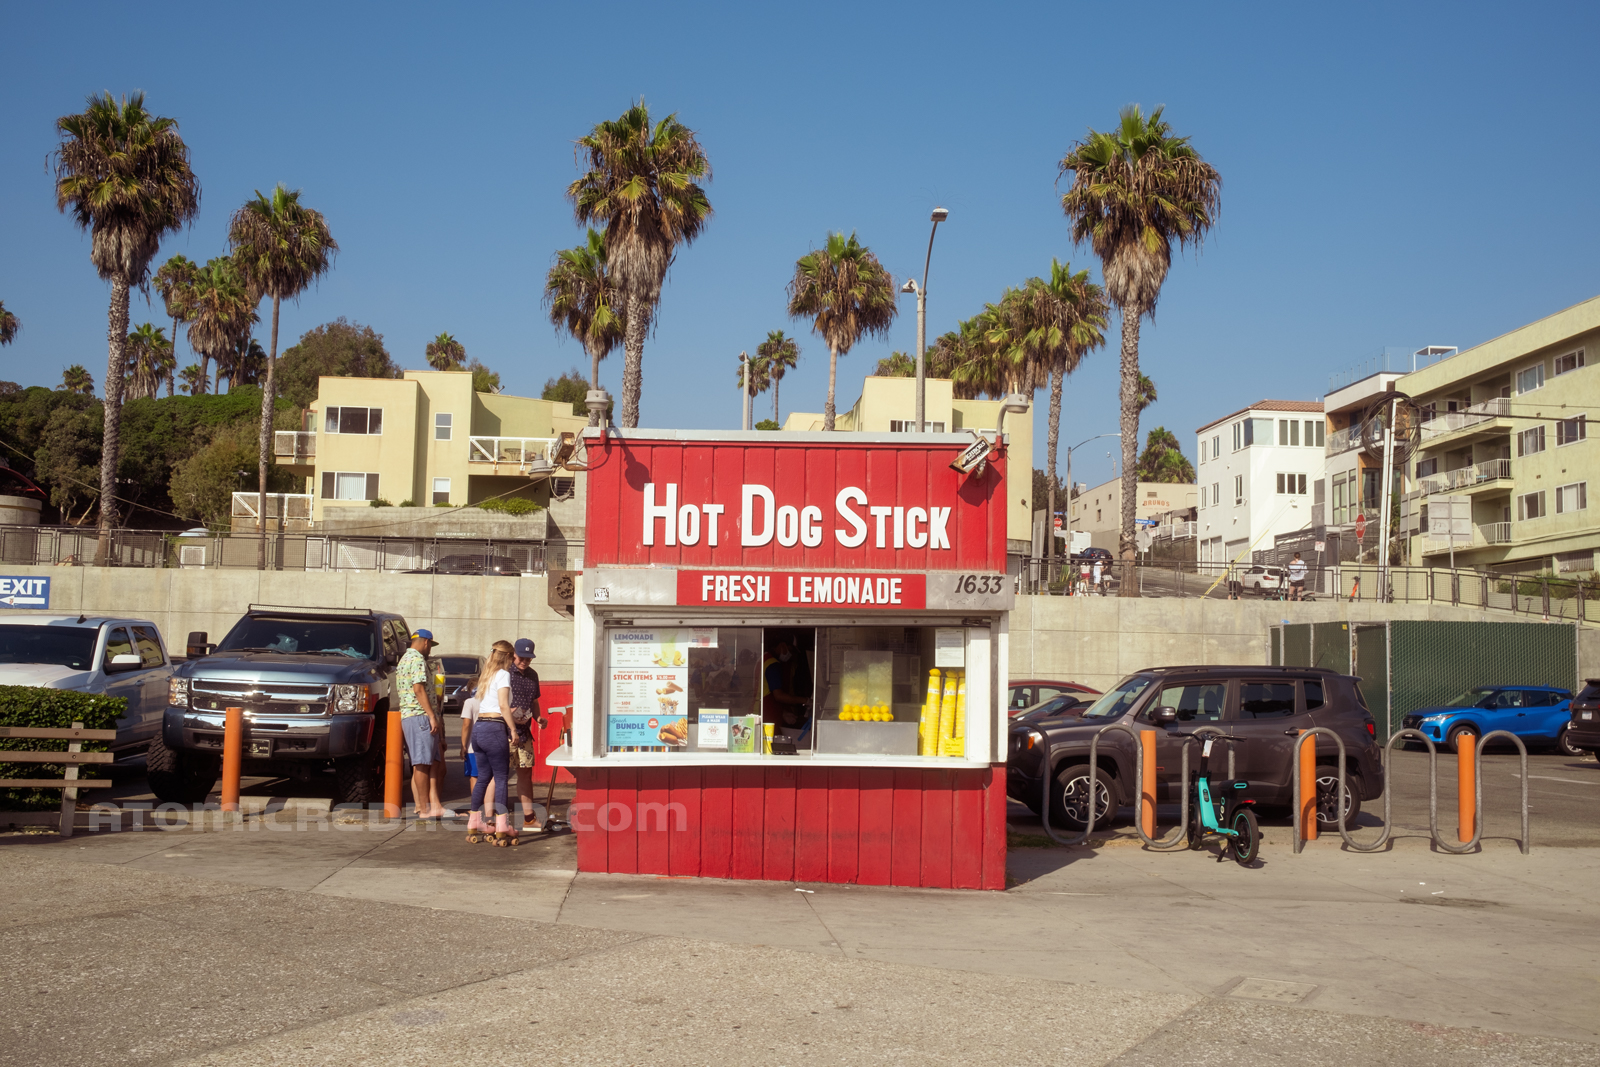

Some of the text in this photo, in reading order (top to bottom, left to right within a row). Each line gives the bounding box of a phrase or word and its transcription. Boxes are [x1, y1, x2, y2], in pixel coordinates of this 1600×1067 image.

[643, 482, 952, 549] HOT DOG STICK
[0, 579, 47, 595] EXIT
[702, 575, 902, 605] FRESH LEMONADE
[955, 575, 1005, 594] 1633
